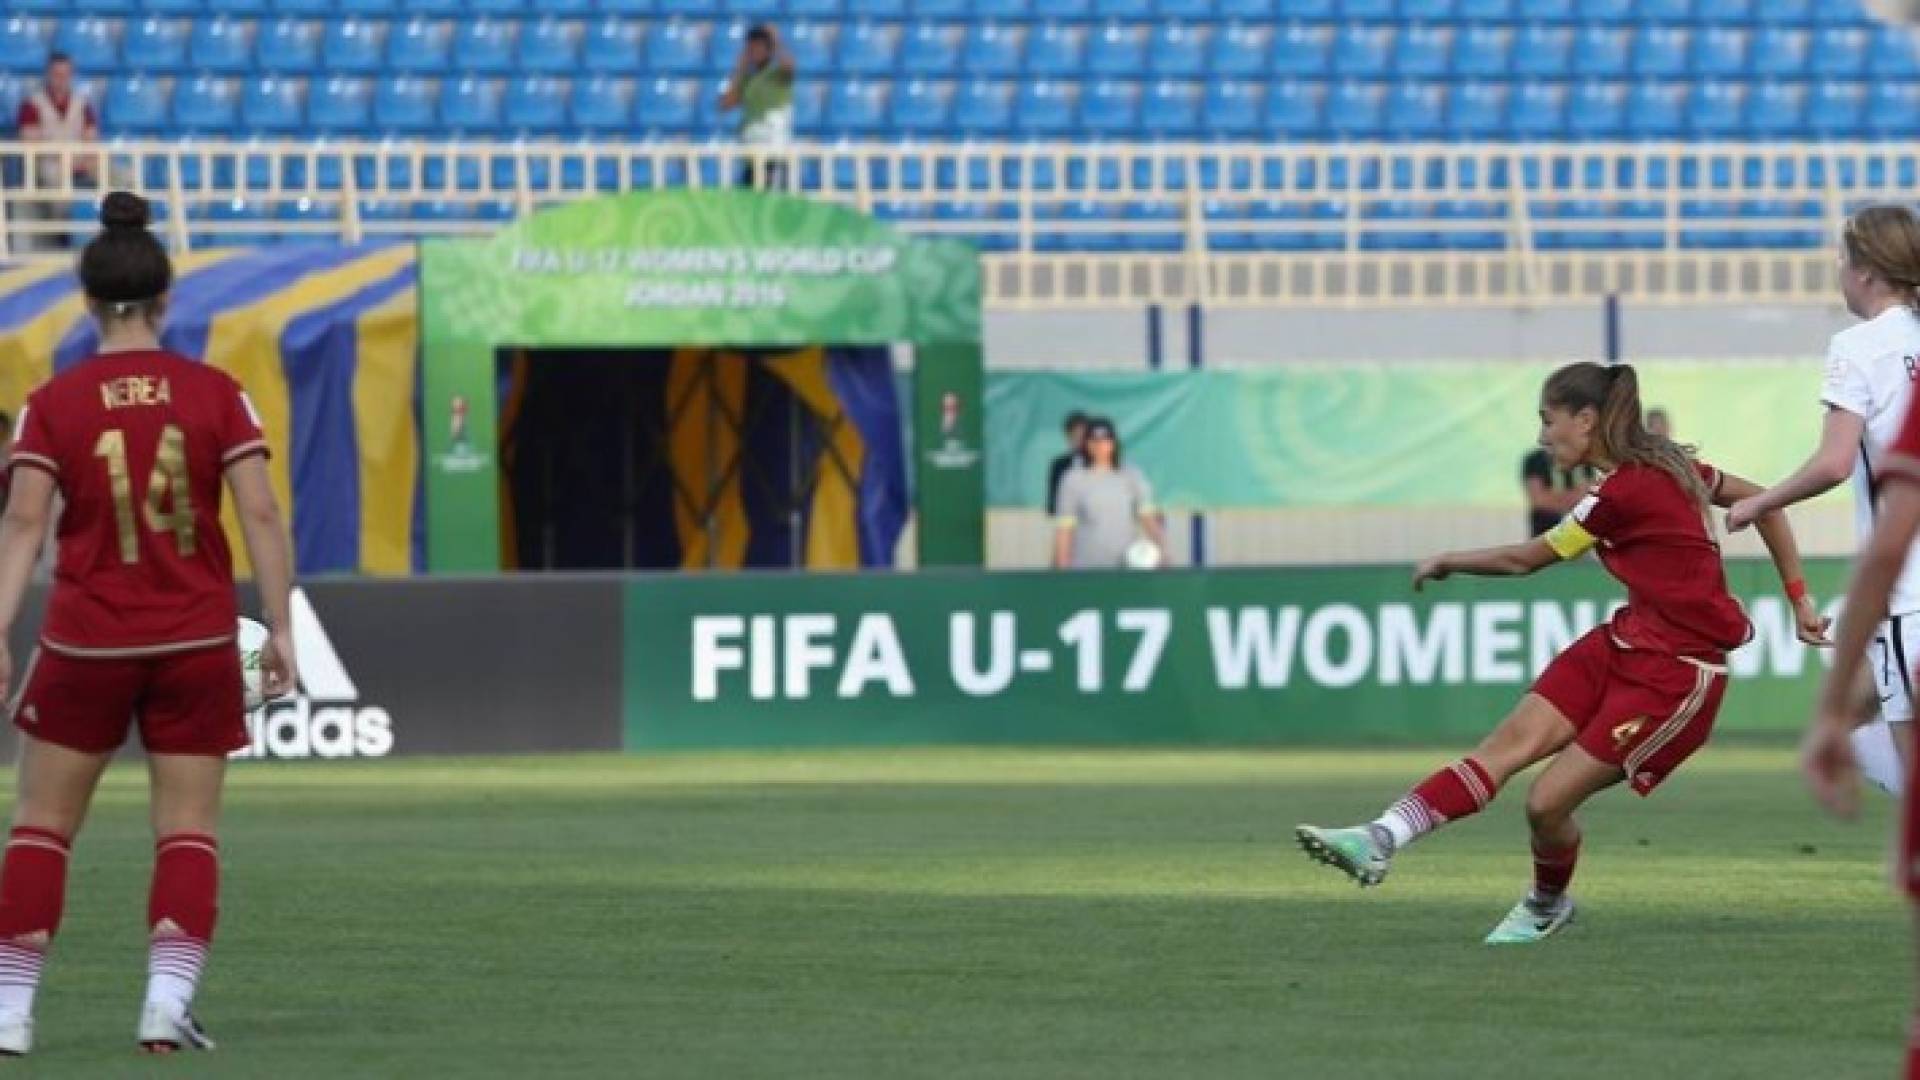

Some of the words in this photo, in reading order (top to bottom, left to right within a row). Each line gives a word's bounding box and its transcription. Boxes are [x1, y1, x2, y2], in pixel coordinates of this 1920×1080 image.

[101, 375, 171, 410] NEREA
[93, 424, 196, 564] 14
[692, 613, 916, 701] FIFA
[949, 608, 1172, 697] U-17
